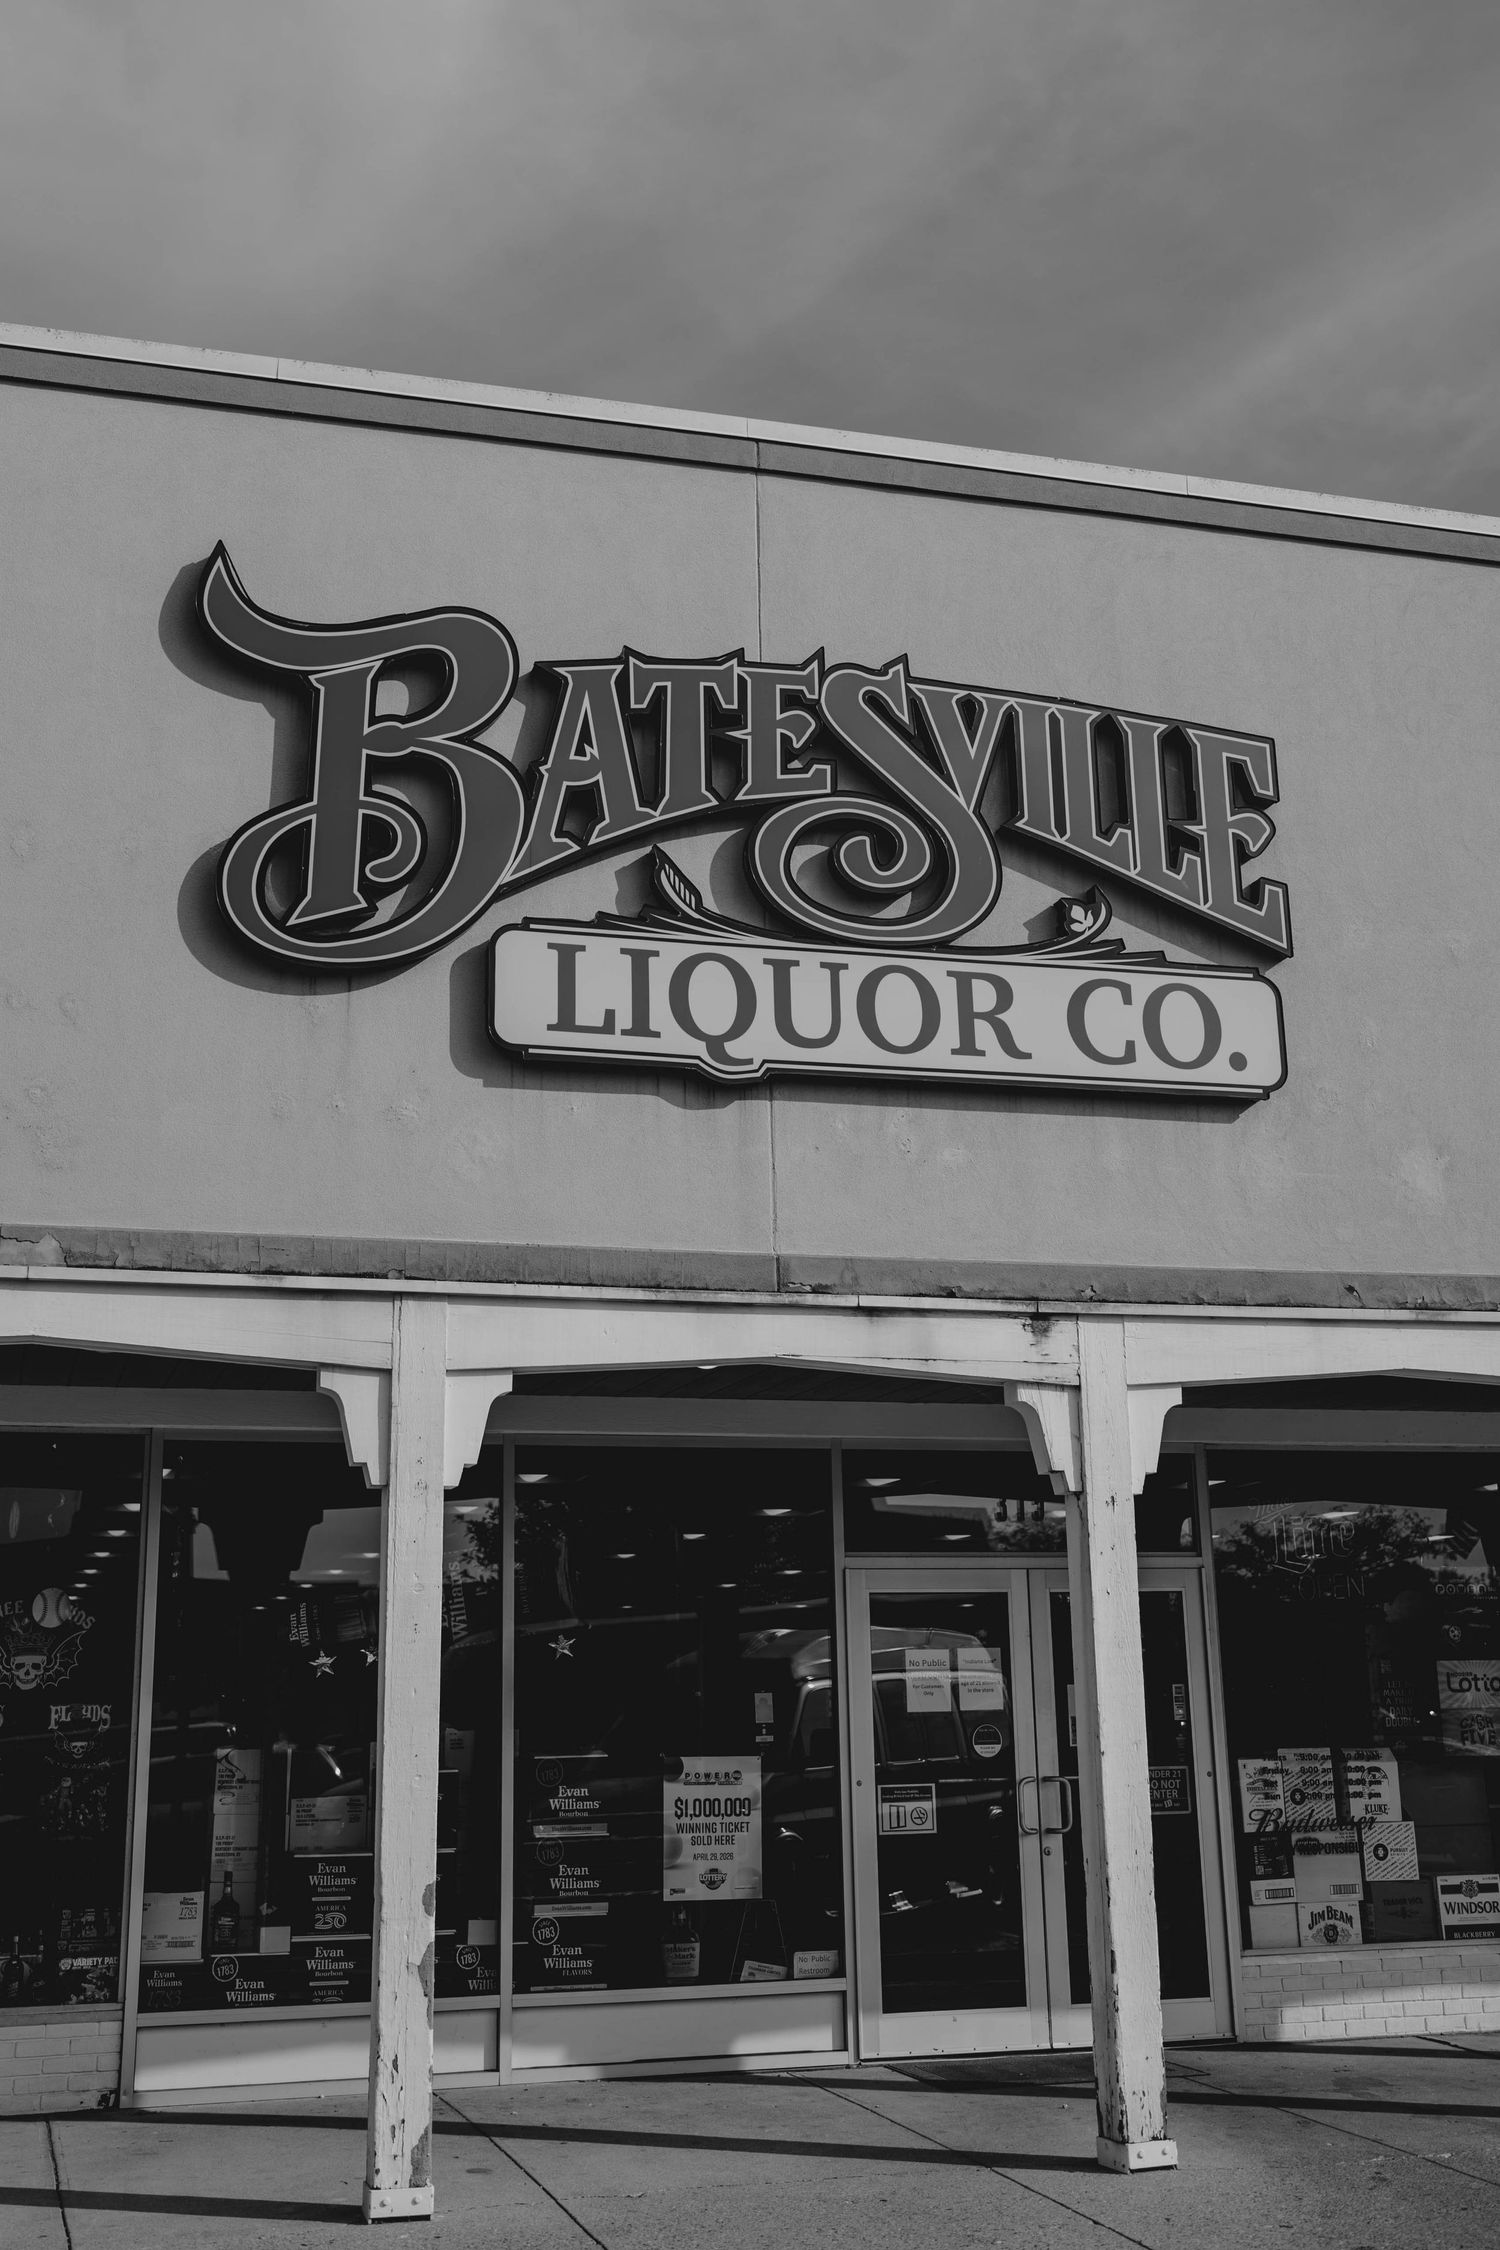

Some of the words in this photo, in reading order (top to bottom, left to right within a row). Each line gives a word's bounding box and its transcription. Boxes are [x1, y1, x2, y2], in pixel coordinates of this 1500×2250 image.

[545, 941, 1033, 1064] LIQUOR
[1064, 978, 1248, 1073] CO.
[908, 1659, 920, 1667] No
[921, 1658, 948, 1667] Public
[1149, 1770, 1170, 1778] NDER
[1160, 1779, 1182, 1789] NOT
[559, 1785, 590, 1797] Evan
[548, 1798, 600, 1811] Williams
[674, 1796, 752, 1820] $1,000,000
[675, 1822, 718, 1834] WINNING
[719, 1821, 751, 1833] TICKET
[690, 1835, 713, 1846] SOLD
[714, 1834, 736, 1846] HERE
[692, 1852, 709, 1861] APRIL
[316, 1862, 347, 1874] Evan
[558, 1864, 590, 1876] Evan
[308, 1874, 357, 1886] Williams
[549, 1877, 600, 1890] Williams
[315, 1904, 347, 1912] AMERICA
[1443, 1900, 1500, 1915] WINDSOR
[1308, 1909, 1326, 1931] JIM
[1326, 1905, 1354, 1930] BEAM
[537, 1926, 556, 1941] 1783
[314, 1946, 345, 1958] Evan
[552, 1944, 584, 1956] Evan
[72, 1957, 103, 1966] VARIETY
[460, 1952, 477, 1966] 1783
[543, 1957, 593, 1969] Williams
[798, 1955, 809, 1963] No
[811, 1954, 831, 1963] Public
[216, 1963, 235, 1977] 1783
[306, 1959, 355, 1971] Williams
[799, 1966, 830, 1975] Restroom
[153, 1970, 176, 1979] Evan
[146, 1979, 183, 1988] Williams
[234, 1978, 266, 1990] Evan
[225, 1991, 275, 2003] Williams
